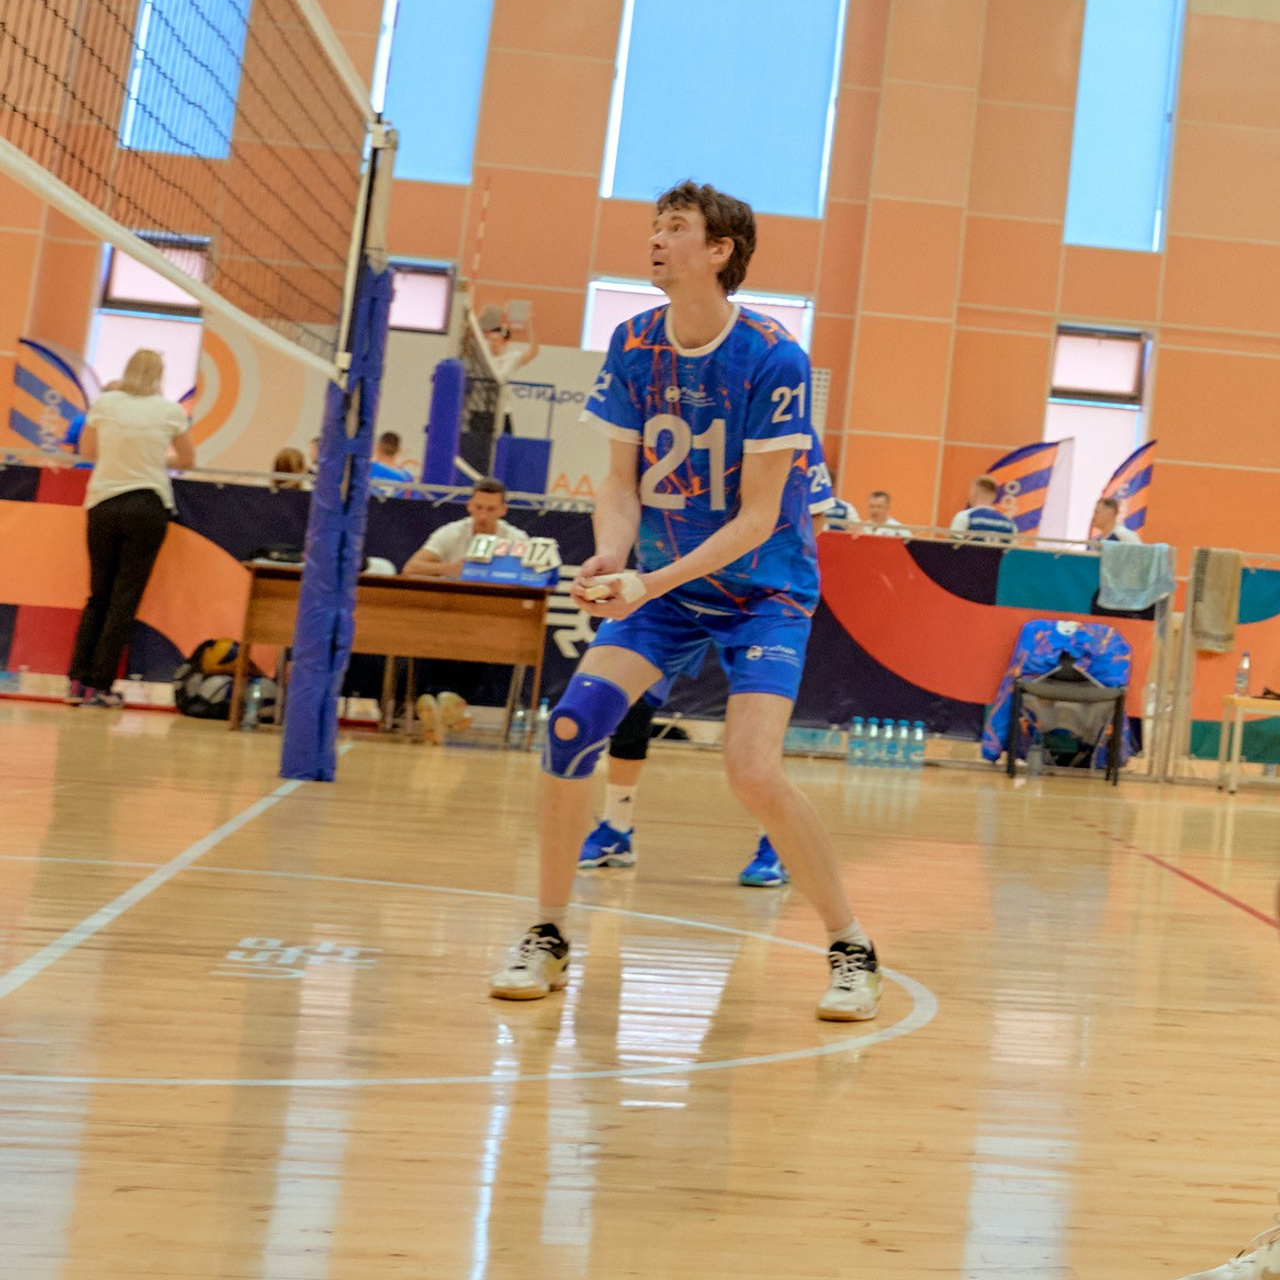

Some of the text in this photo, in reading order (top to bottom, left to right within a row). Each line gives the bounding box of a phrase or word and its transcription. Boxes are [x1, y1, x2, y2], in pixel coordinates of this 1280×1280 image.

[771, 382, 806, 424] 21
[640, 414, 726, 511] 21
[528, 542, 550, 561] 17
